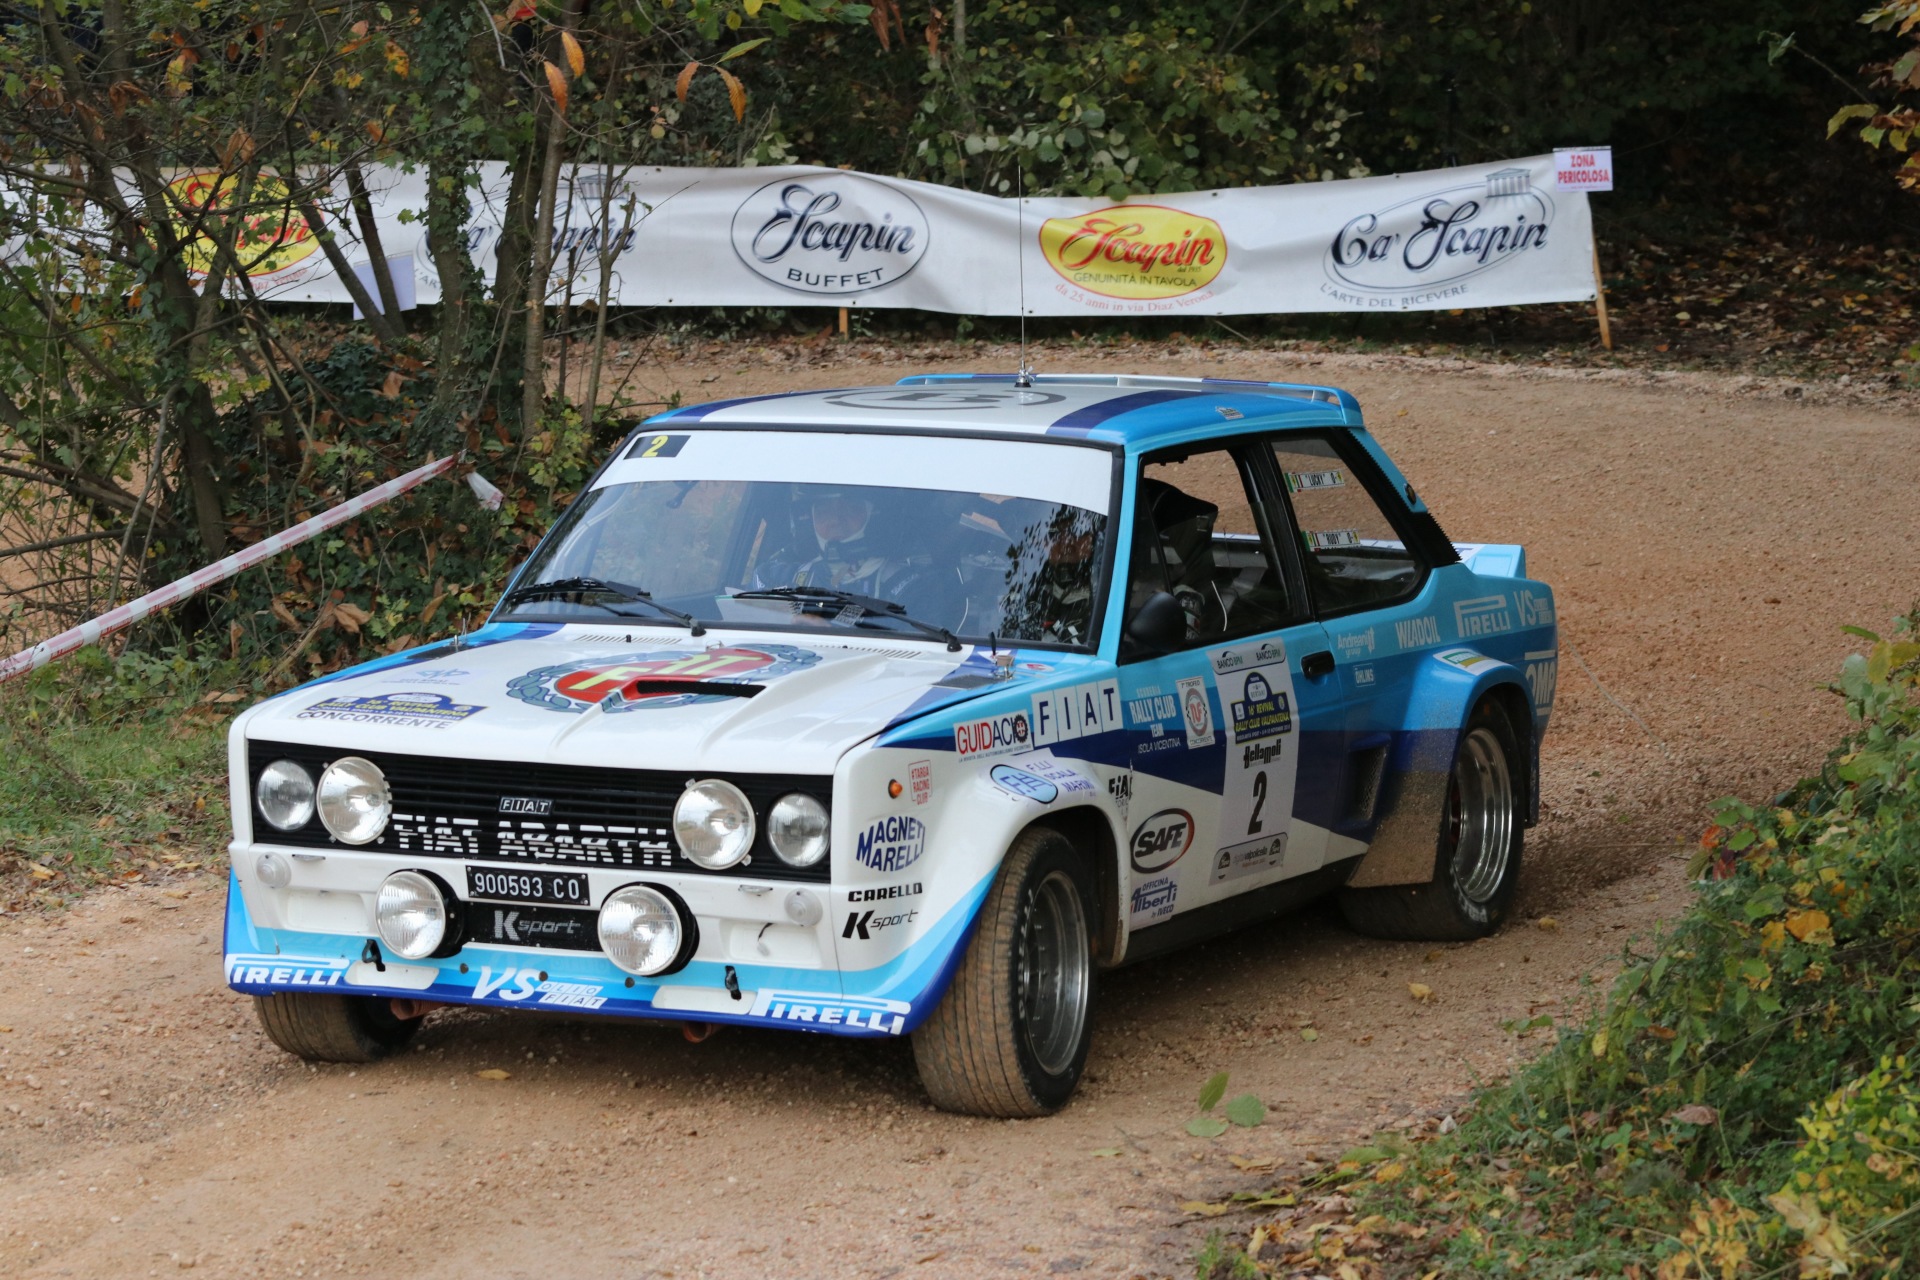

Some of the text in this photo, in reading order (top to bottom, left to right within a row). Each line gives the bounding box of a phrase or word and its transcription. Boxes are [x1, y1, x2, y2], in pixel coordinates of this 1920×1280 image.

[1571, 154, 1595, 168] ZONA
[1557, 169, 1610, 184] PERICOLOSA
[751, 183, 916, 264] Scapin
[1058, 217, 1215, 272] Scapin
[1331, 199, 1548, 273] Ca' Scapin
[786, 267, 884, 287] BUFFET
[1074, 272, 1197, 287] GENUINITÀ IN TAVOLA
[1055, 283, 1214, 312] da 25 anni in via Diaz Verona
[1319, 282, 1469, 308] L'ARTE DEL RICEVERE
[642, 435, 669, 458] 2
[1453, 594, 1511, 638] PIRELLI
[1513, 589, 1538, 627] VS
[1217, 659, 1233, 669] BANCO
[1256, 650, 1272, 660] BANCO
[389, 700, 440, 709] REVIVAL
[389, 705, 469, 717] VALPANTENA
[1039, 687, 1115, 735] FIAT
[1129, 697, 1154, 724] RALLY
[1155, 694, 1177, 722] CLUB
[1256, 701, 1275, 713] REVIVAL
[296, 710, 452, 730] CONCORRENTE
[1235, 711, 1290, 732] RALLY CLUB VALPANTENA
[1150, 723, 1165, 738] TEAM
[1137, 737, 1181, 754] ISOLA VICENTINA
[1044, 769, 1078, 780] SCALA
[913, 779, 930, 792] RACING
[1062, 778, 1095, 792] MARMI
[502, 799, 549, 814] FIAT
[916, 793, 929, 805] CLUB
[1247, 770, 1268, 836] 2
[391, 813, 672, 867] FIAT ABARTH
[858, 816, 926, 850] MAGNETI
[1135, 822, 1187, 858] SAFE
[856, 838, 925, 872] MARELLI
[475, 873, 580, 901] 900593 CO
[848, 882, 923, 902] CARELLO
[1142, 876, 1169, 891] OFFICINA
[223, 953, 350, 986] PIRELLI
[471, 965, 542, 1001] VS
[541, 983, 598, 996] OLIO
[544, 994, 604, 1007] FIAT
[749, 988, 911, 1035] PIRELLI
